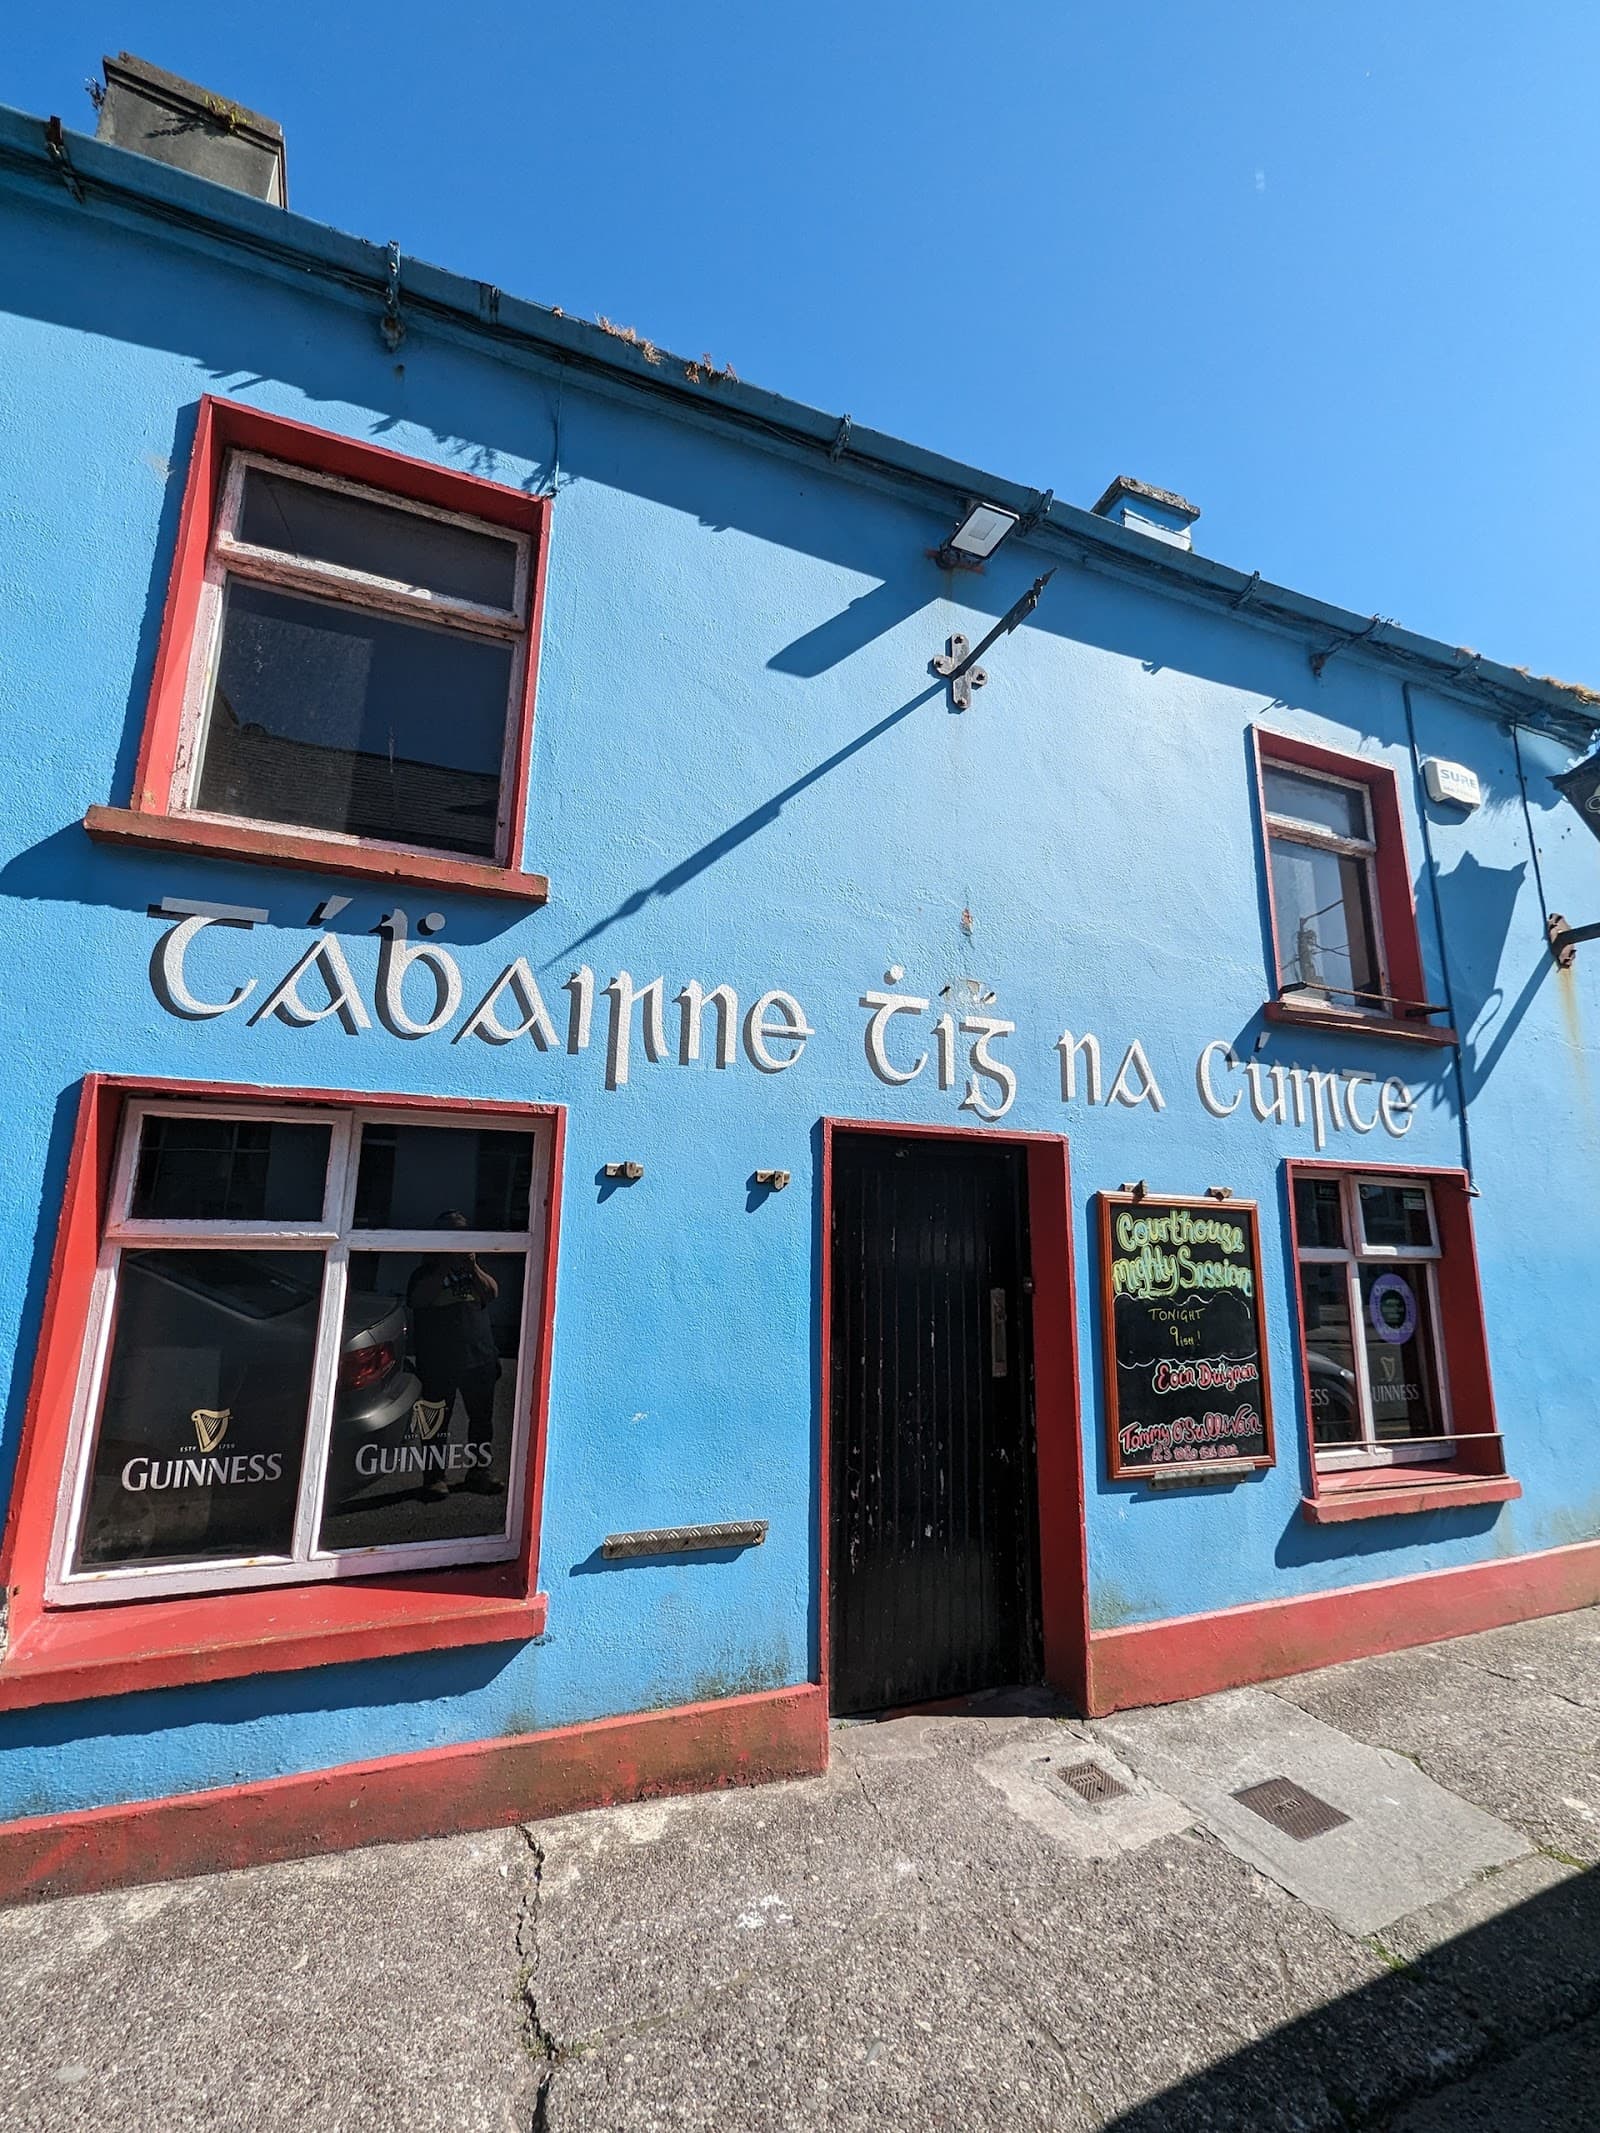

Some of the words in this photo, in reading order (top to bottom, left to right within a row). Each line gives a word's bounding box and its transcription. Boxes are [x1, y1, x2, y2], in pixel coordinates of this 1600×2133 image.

[1116, 1208, 1246, 1254] Courthouse
[1148, 1307, 1206, 1323] TONIGHT
[1152, 1361, 1197, 1394] Eoin
[1118, 1421, 1173, 1455] Tommy
[121, 1453, 283, 1492] GUINNESS
[355, 1442, 493, 1475] GUINNESS
